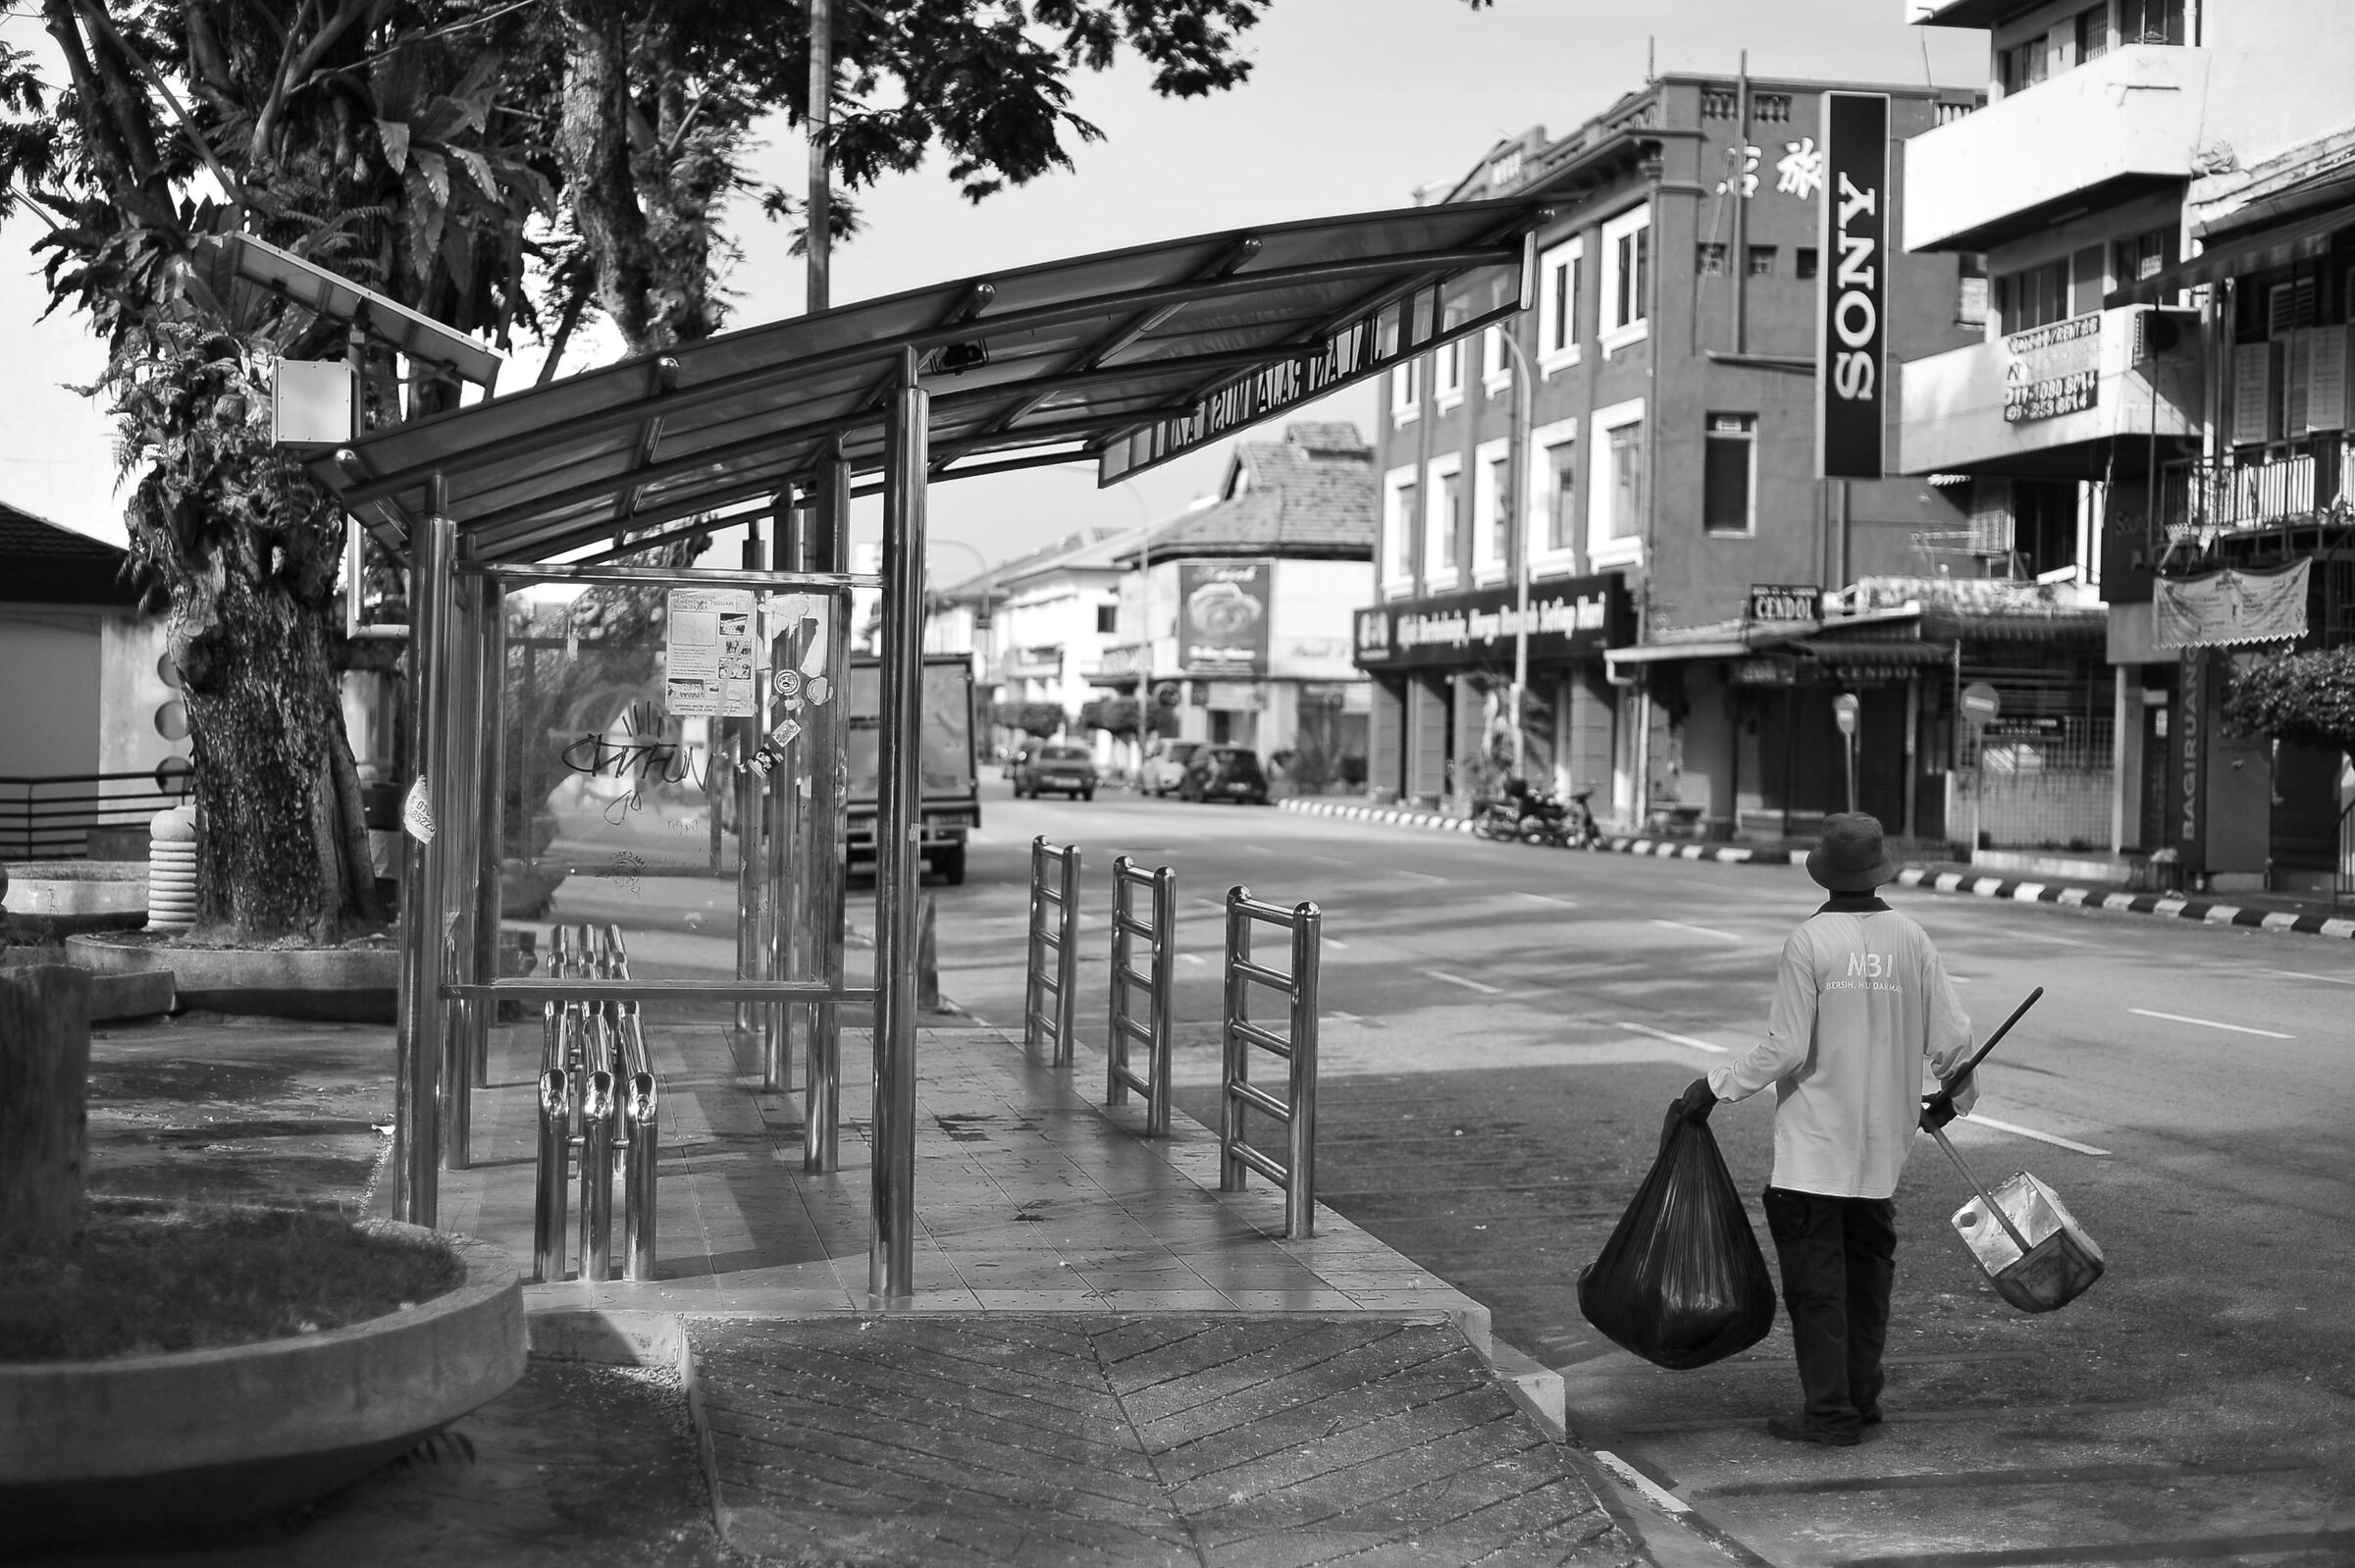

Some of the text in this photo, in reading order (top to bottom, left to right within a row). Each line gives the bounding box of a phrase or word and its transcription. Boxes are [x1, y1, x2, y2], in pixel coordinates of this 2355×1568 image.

[1834, 171, 1876, 400] SONY
[1754, 595, 1813, 620] CENDOL
[1847, 952, 1893, 978] MBI
